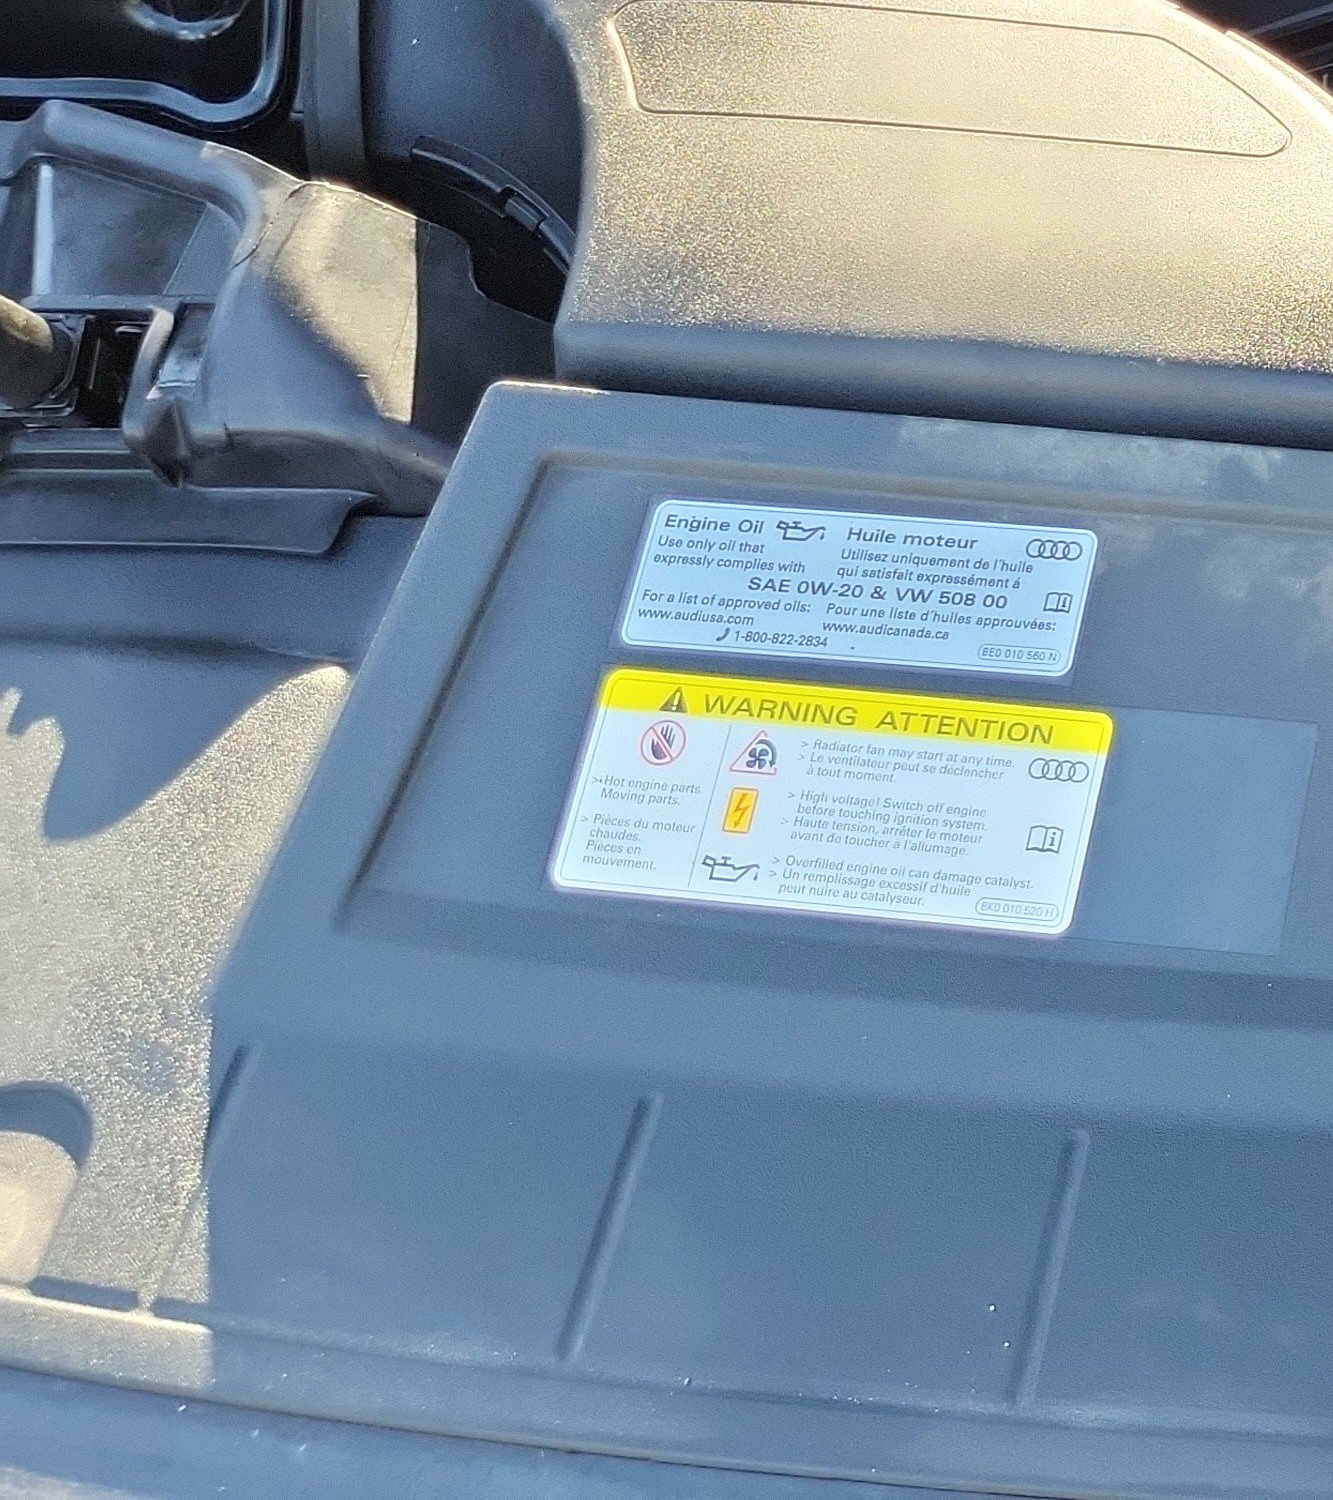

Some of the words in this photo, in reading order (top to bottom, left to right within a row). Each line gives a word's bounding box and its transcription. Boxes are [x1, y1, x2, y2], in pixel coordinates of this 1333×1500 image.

[663, 515, 731, 534] Engine
[737, 519, 765, 532] Oil
[656, 535, 683, 547] Use
[685, 537, 716, 552] only
[717, 539, 737, 550] oil
[737, 541, 766, 552] that
[846, 527, 897, 543] Huile
[901, 532, 979, 549] moteur
[652, 552, 715, 568] expressly
[715, 556, 775, 572] complies
[776, 559, 807, 571] with
[839, 548, 889, 561] Utilisez
[890, 552, 971, 570] uniquement
[972, 558, 990, 569] de
[835, 565, 858, 579] qui
[860, 567, 914, 580] satisfait
[641, 589, 663, 601] For
[666, 593, 675, 602] a
[677, 592, 699, 603] list
[699, 594, 716, 605] of
[716, 595, 781, 612] approved
[782, 600, 811, 612] oils:
[746, 577, 792, 593] SAE
[796, 580, 864, 598] 0W-20
[869, 585, 887, 599] &
[892, 587, 933, 602] VW
[938, 589, 977, 605] 508
[982, 592, 1009, 607] 00
[636, 607, 755, 624] www.audiusa.com
[825, 603, 859, 615] Pour
[859, 608, 886, 617] une
[887, 608, 917, 620] liste
[732, 630, 828, 646] 1-800-822-2834
[820, 620, 950, 638] www.audicanada.ca
[702, 694, 859, 726] WARNING
[873, 709, 1057, 744] ATTENTION
[812, 739, 862, 752] Radiator
[865, 744, 886, 755] fan
[887, 748, 914, 760] may
[915, 749, 944, 760] start
[945, 752, 959, 761] at
[959, 755, 983, 766] any
[809, 753, 824, 763] Le
[826, 754, 889, 768] ventilateur
[892, 760, 920, 773] peut
[921, 764, 937, 772] se
[816, 767, 841, 777] tout
[603, 775, 626, 786] Hot
[626, 777, 668, 793] engine
[599, 787, 646, 804] Moving
[799, 791, 829, 804] High
[881, 798, 925, 810] Switch
[925, 802, 944, 812] off
[945, 803, 987, 818] engine
[632, 817, 649, 828] du
[651, 820, 695, 832] moteur
[795, 804, 836, 816] before
[837, 807, 891, 823] touching
[892, 812, 940, 827] ignition
[940, 816, 987, 831] system.
[588, 827, 641, 841] chaudes.
[792, 817, 829, 829] Haute
[830, 820, 878, 836] tension,
[924, 828, 937, 838] le
[938, 830, 982, 841] moteur
[789, 831, 824, 842] avant
[824, 833, 842, 843] de
[843, 835, 889, 847] toucher
[625, 845, 642, 854] en
[781, 869, 800, 879] Un
[802, 871, 876, 889] remplissage
[877, 878, 927, 891] excessif
[784, 855, 844, 870] Overfilled
[845, 861, 888, 876] engine
[889, 865, 906, 876] oil
[907, 869, 930, 878] can
[931, 869, 982, 885] damage
[983, 874, 1032, 890] catalyst.
[777, 884, 806, 896] peut
[807, 885, 840, 897] nuire
[841, 890, 858, 898] au
[859, 890, 924, 906] catalyseur.
